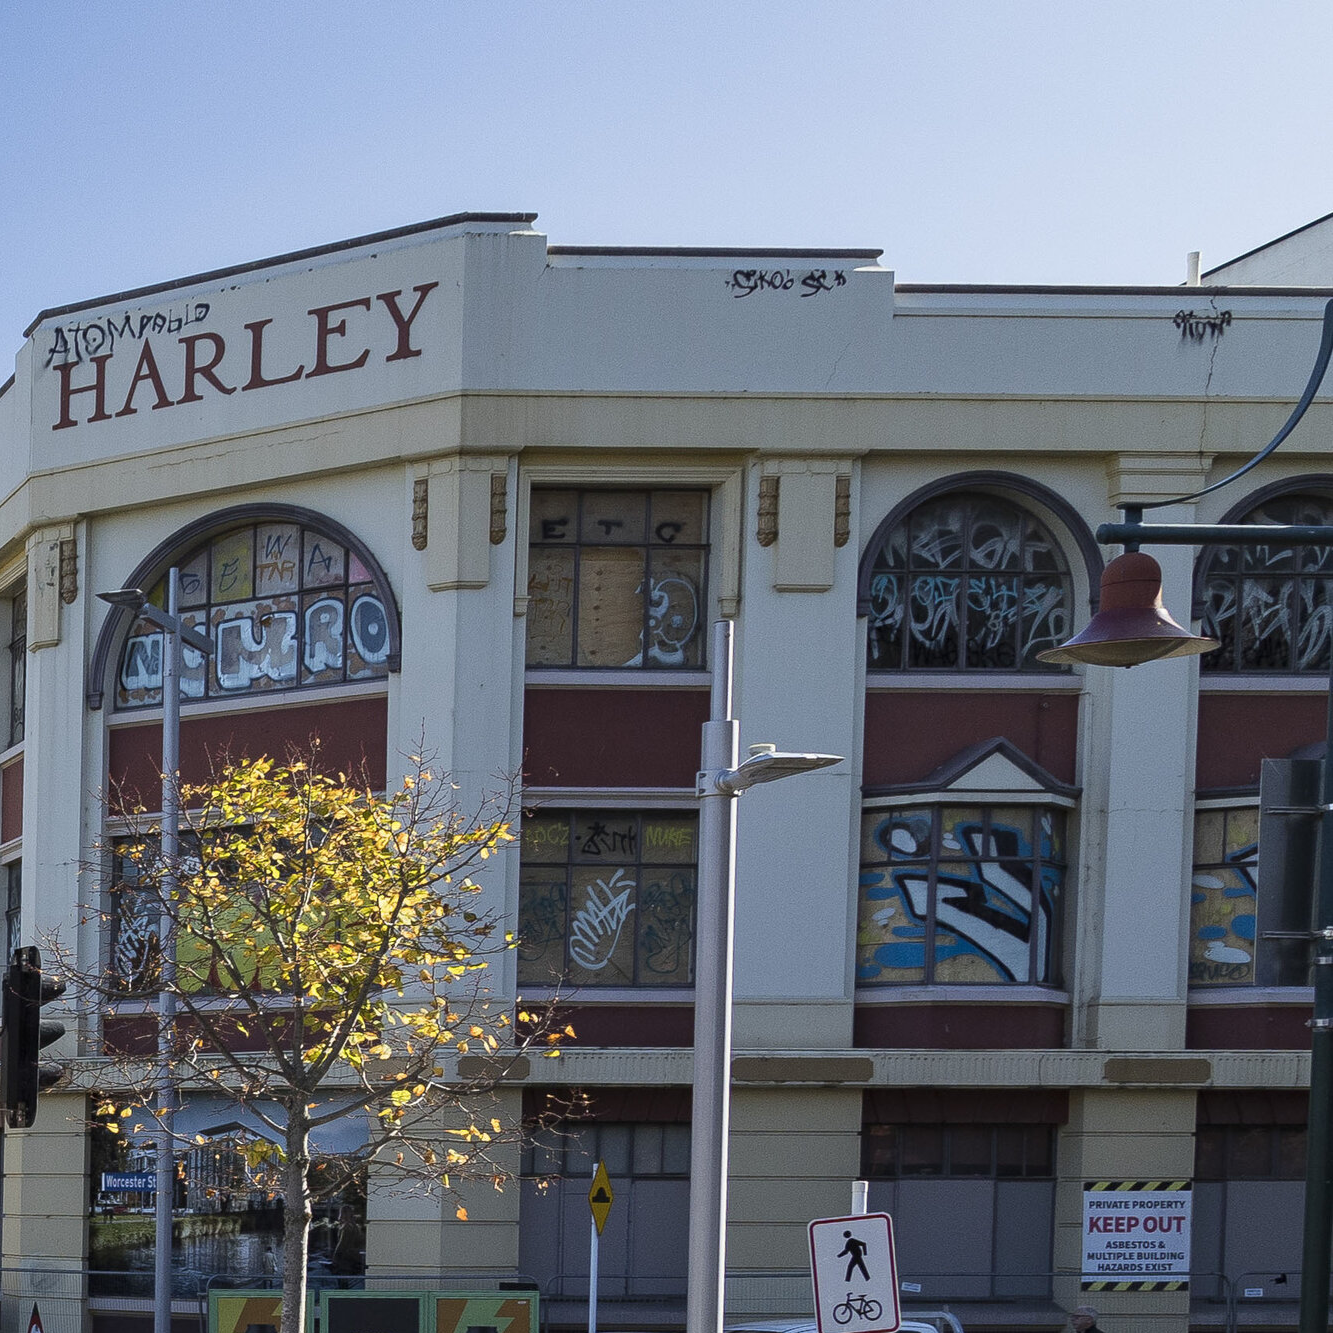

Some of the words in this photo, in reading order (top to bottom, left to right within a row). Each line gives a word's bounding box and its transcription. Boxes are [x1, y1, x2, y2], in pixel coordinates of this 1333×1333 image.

[52, 281, 439, 431] HARLEY
[106, 1175, 146, 1188] Worcester
[147, 1175, 157, 1188] St
[1088, 1200, 1130, 1209] PRIVATE
[1132, 1200, 1186, 1209] PROPERTY
[1088, 1216, 1140, 1234] KEEP
[1142, 1216, 1186, 1234] OUT
[1105, 1240, 1157, 1249] ASBESTOS
[1158, 1240, 1166, 1249] &
[1087, 1252, 1136, 1260] MULTIPLE
[1137, 1252, 1185, 1260] BUILDING
[1098, 1263, 1143, 1272] HAZARDS
[1145, 1262, 1173, 1271] EXIST
